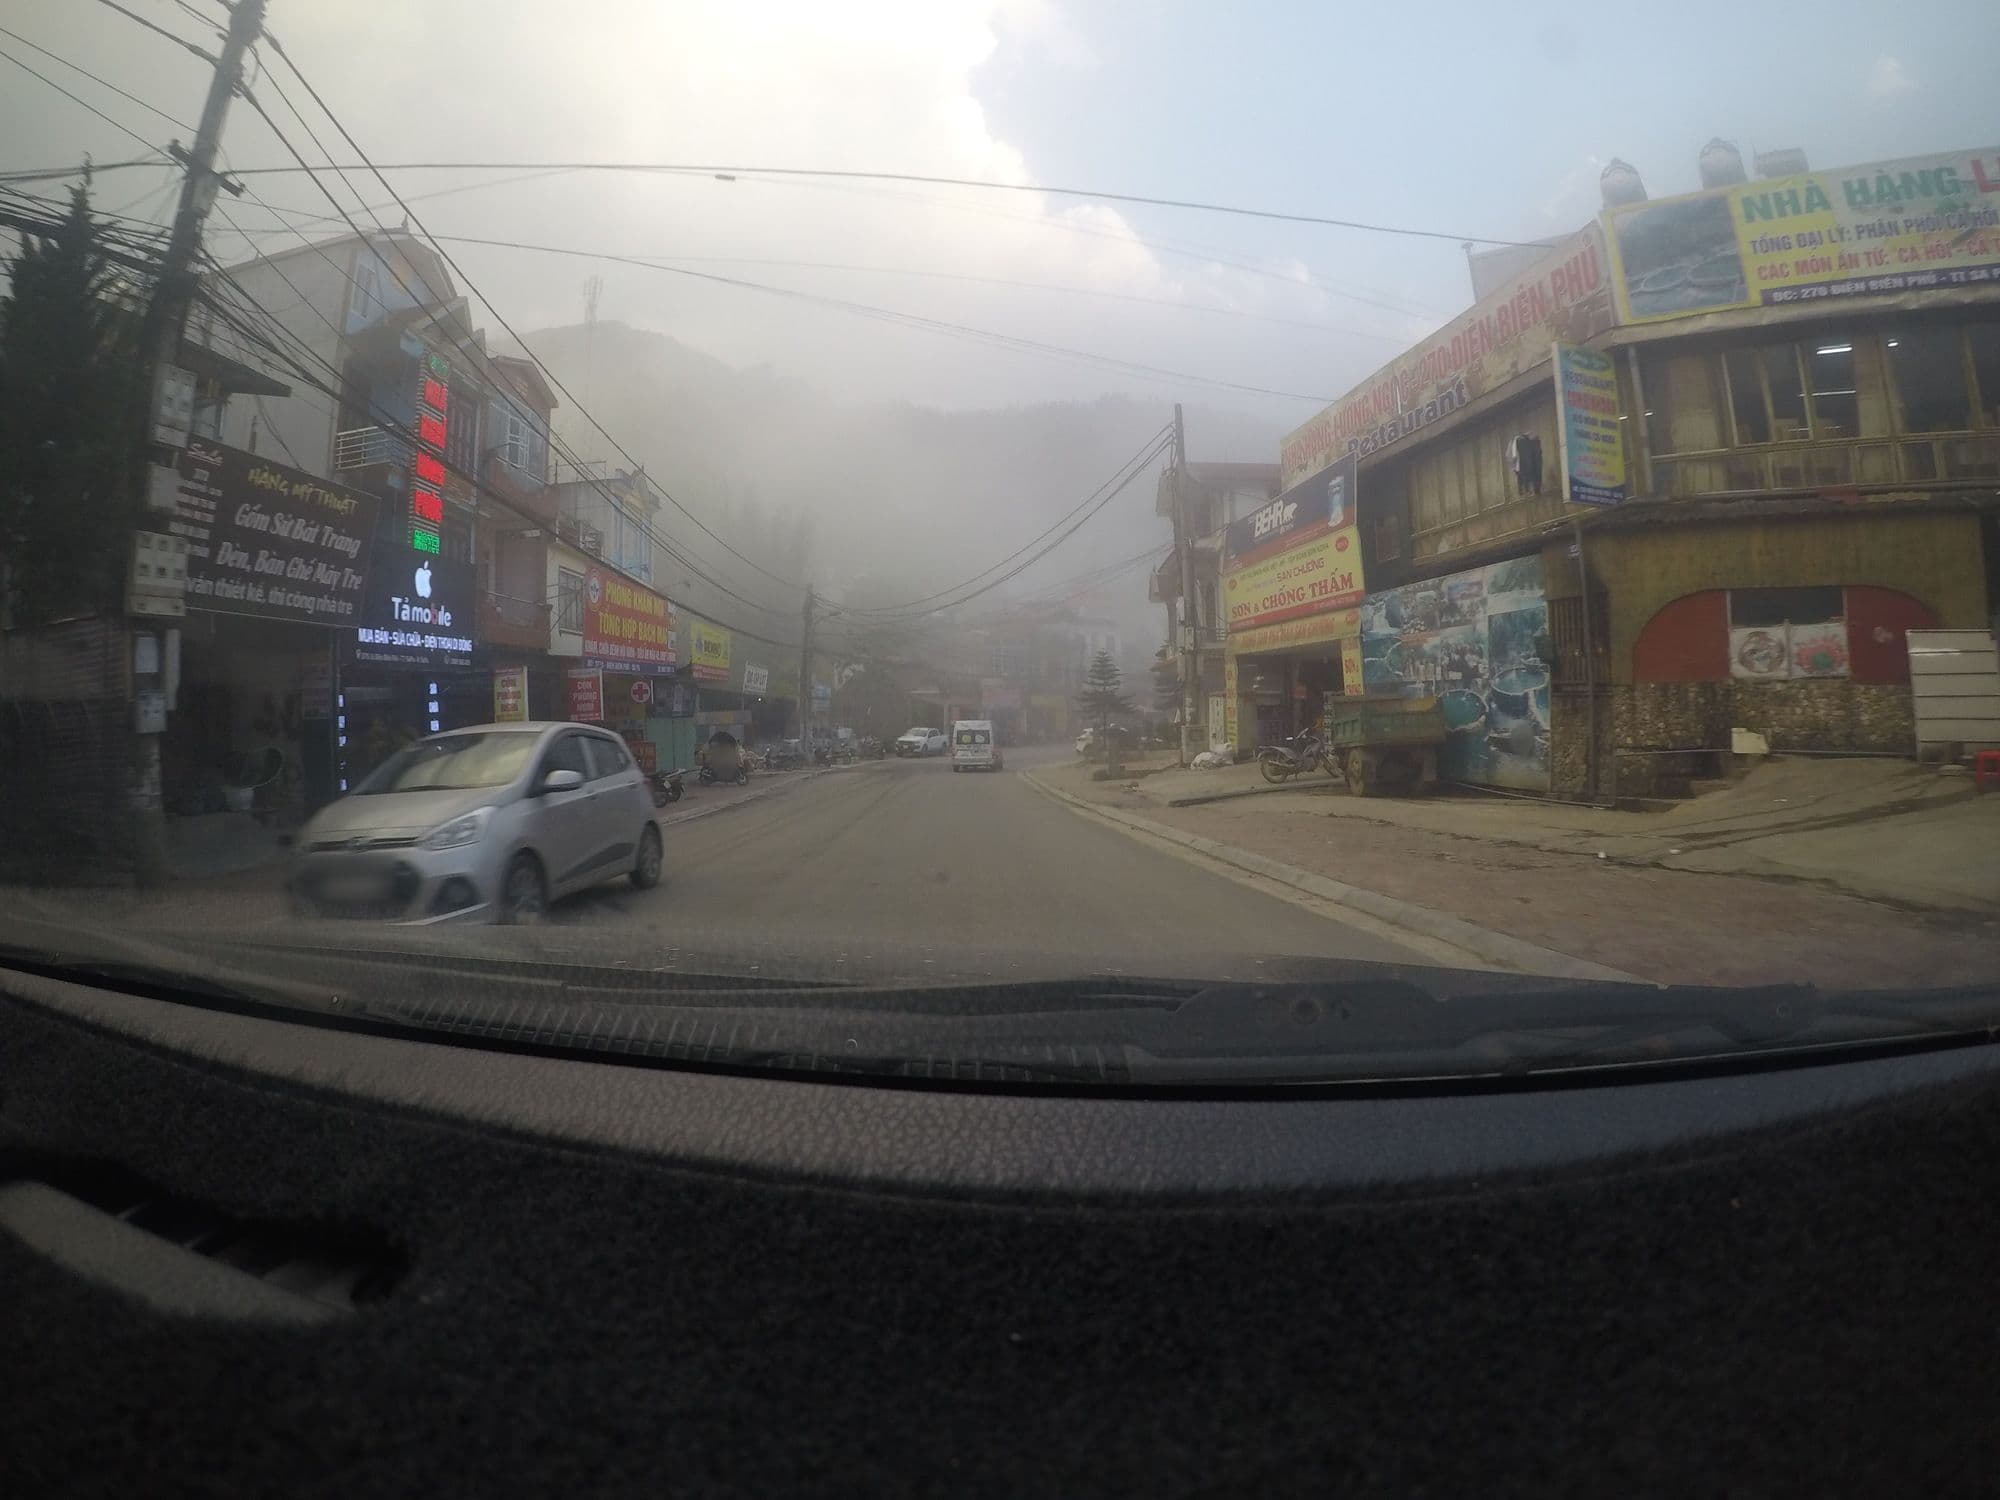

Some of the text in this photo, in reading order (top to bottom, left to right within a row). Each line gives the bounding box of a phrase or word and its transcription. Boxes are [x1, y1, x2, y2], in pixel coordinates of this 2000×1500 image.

[1741, 180, 1832, 223] NHÀ
[1843, 166, 1960, 207] HÀNG
[1749, 232, 1792, 255] TỔNG
[248, 465, 289, 496] HÀNG
[235, 503, 271, 532] Gốm
[321, 525, 361, 559] Tràng
[1255, 500, 1284, 538] BEHR
[254, 549, 285, 577] Bàn
[341, 567, 362, 590] Tre
[286, 592, 316, 615] công
[1232, 600, 1251, 618] SƠN
[1262, 584, 1306, 611] CHỐNG
[1309, 567, 1354, 598] THẤM
[358, 627, 373, 643] MUA
[374, 626, 390, 645] BÁN
